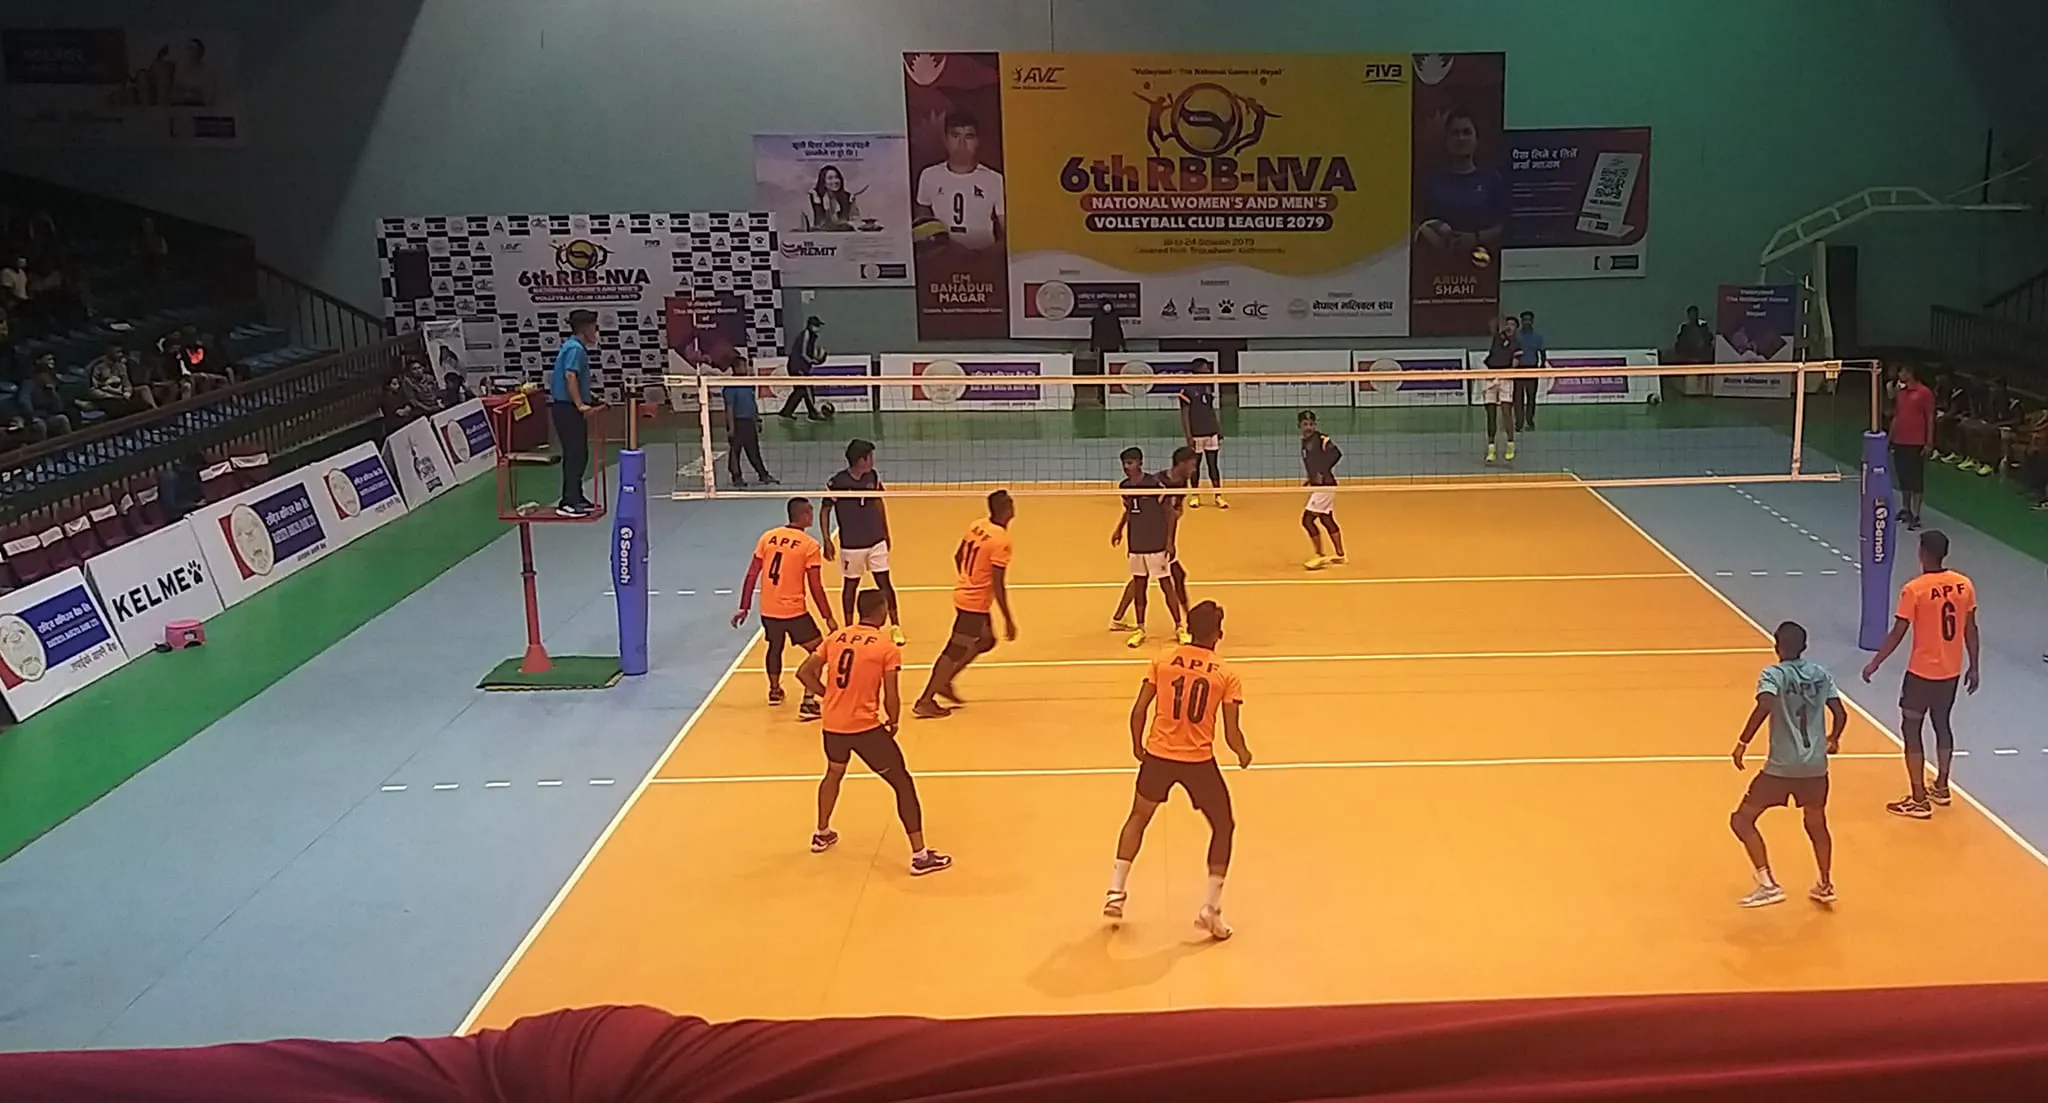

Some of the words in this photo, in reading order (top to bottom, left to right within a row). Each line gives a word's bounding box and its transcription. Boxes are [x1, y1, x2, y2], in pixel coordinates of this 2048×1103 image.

[1023, 67, 1064, 83] AVC
[1366, 64, 1402, 78] FIVB
[1060, 155, 1139, 192] 6th
[1146, 156, 1357, 192] RBB-NVA
[953, 192, 964, 225] 9
[1092, 197, 1168, 209] NATIONAL
[1171, 197, 1243, 209] WOMEN'S
[1246, 197, 1278, 209] AND
[1282, 197, 1327, 209] MEN'S
[1094, 216, 1186, 229] VOLLEYBALL
[1188, 216, 1225, 229] CLUB
[1228, 216, 1284, 229] LEAGUE
[1286, 216, 1325, 229] 2079
[800, 247, 837, 257] REMIT
[518, 269, 554, 287] 6th
[556, 269, 651, 285] RBB-NVA
[930, 283, 993, 293] BAHADUR
[1435, 285, 1474, 295] SHAHI
[939, 293, 986, 303] MAGAR
[768, 535, 801, 550] APF
[1875, 520, 1886, 563] Senoh
[768, 551, 783, 586] 4
[112, 567, 192, 622] KELME
[1930, 583, 1965, 600] APF
[1941, 601, 1956, 641] 6
[836, 632, 878, 645] APF
[836, 648, 855, 689] 9
[1170, 655, 1220, 673] APF
[1171, 675, 1210, 724] 10
[1795, 704, 1811, 748] 1
